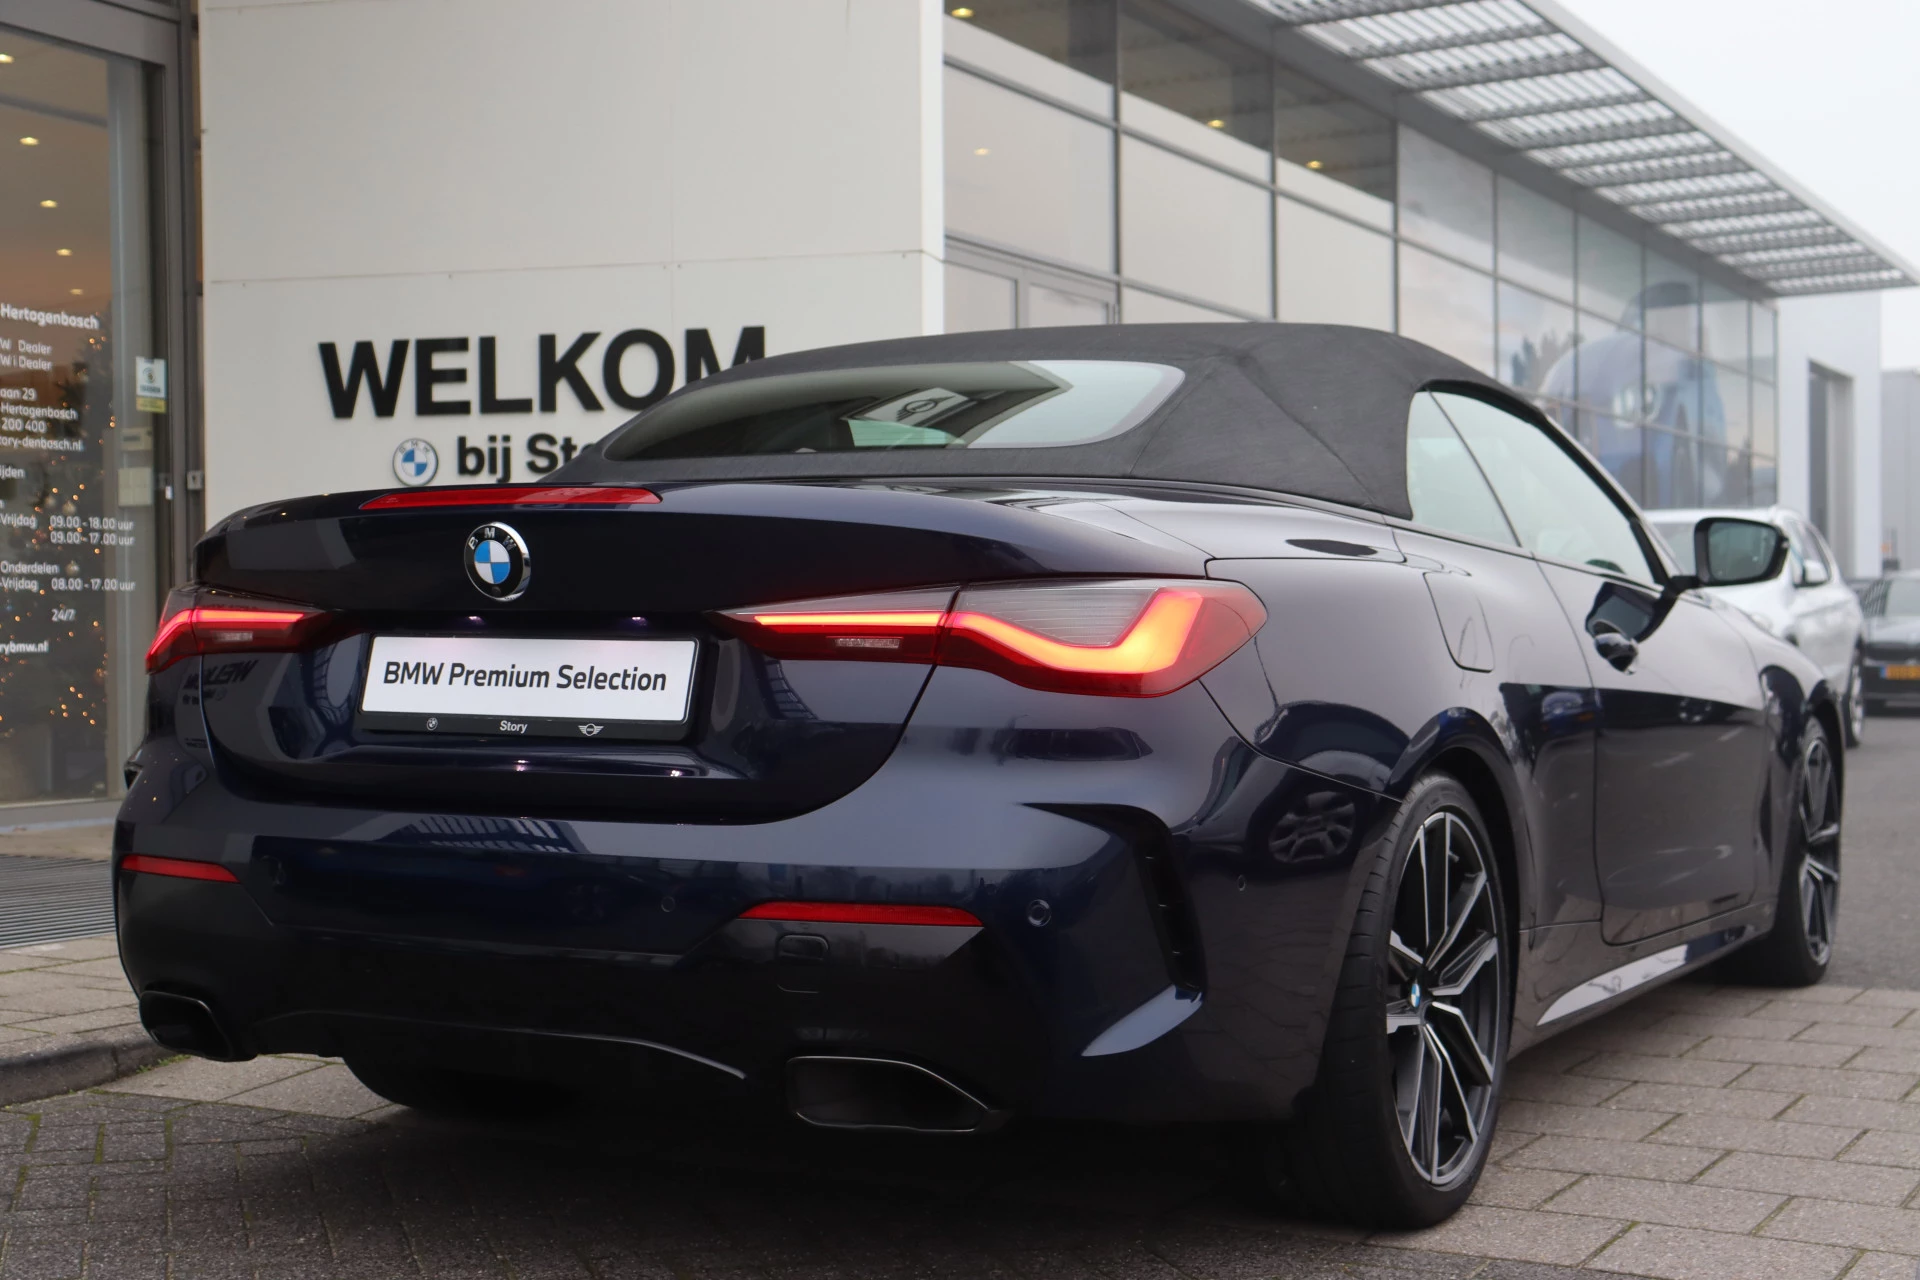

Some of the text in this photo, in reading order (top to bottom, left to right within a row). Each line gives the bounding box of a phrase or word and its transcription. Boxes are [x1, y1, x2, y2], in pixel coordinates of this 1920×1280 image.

[0, 303, 100, 330] Hertogenbosch
[18, 339, 52, 355] Dealer
[18, 355, 52, 371] Dealer
[22, 387, 37, 401] 29
[0, 401, 79, 420] Hertogenbosch
[1, 417, 47, 433] 200 400
[457, 435, 511, 483] bij
[49, 515, 80, 528] 09.00
[88, 516, 117, 530] 18.00
[118, 521, 134, 530] uur
[50, 531, 80, 544] 09.00
[118, 537, 134, 546] uur
[0, 561, 59, 574] Onderdelen
[51, 578, 82, 590] 08.00
[119, 582, 136, 591] uur
[51, 608, 76, 622] 24/7
[383, 661, 667, 691] BMW Premium Selection
[499, 720, 528, 735] Story
